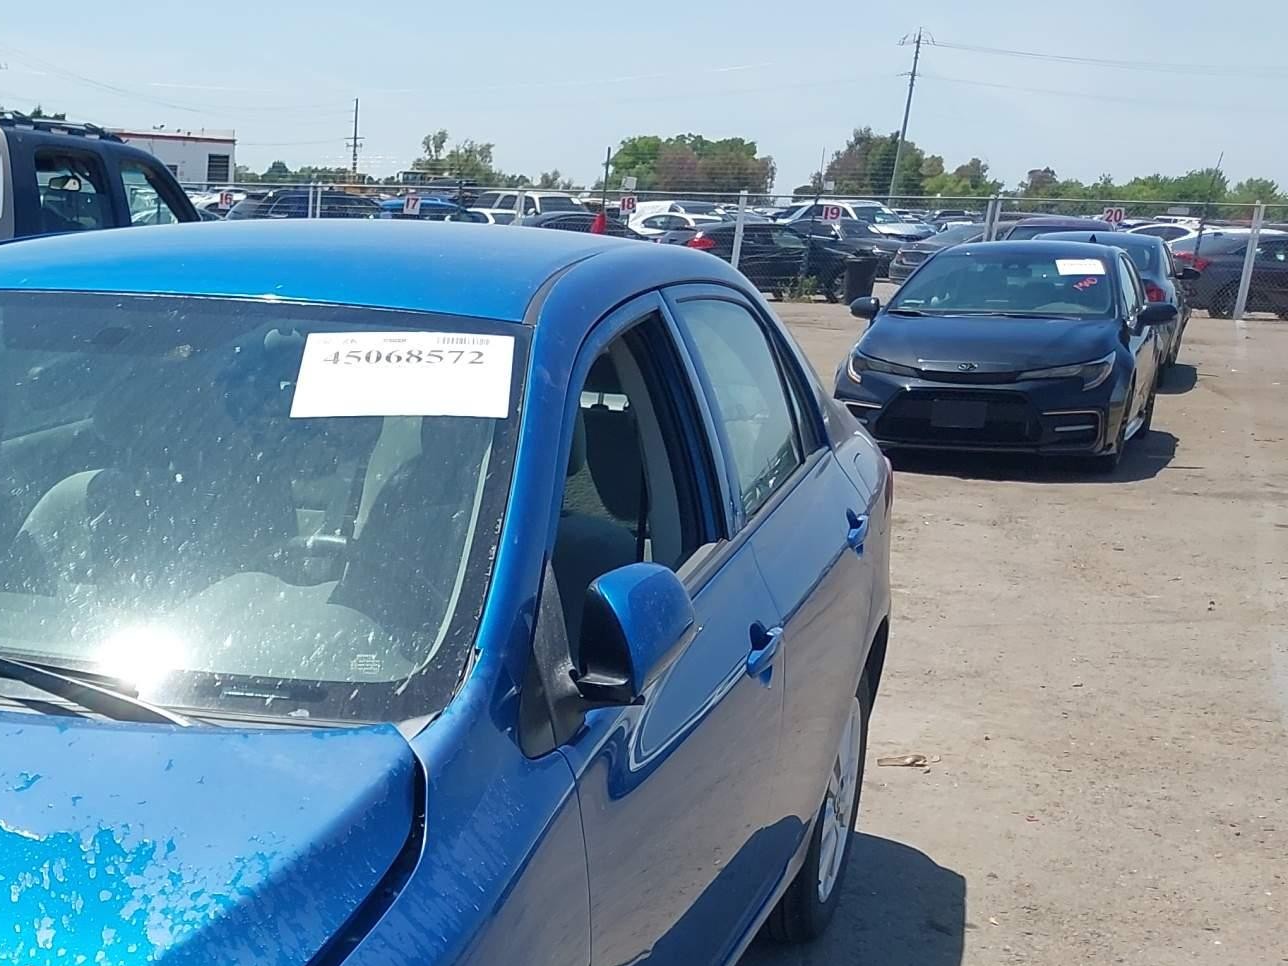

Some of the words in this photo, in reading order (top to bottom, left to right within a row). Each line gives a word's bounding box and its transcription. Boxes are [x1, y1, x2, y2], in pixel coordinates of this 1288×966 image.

[220, 193, 232, 205] 16
[406, 197, 420, 209] 17
[622, 197, 635, 210] 18
[824, 206, 840, 220] 19
[1105, 209, 1122, 222] 20
[323, 350, 485, 365] 45068572
